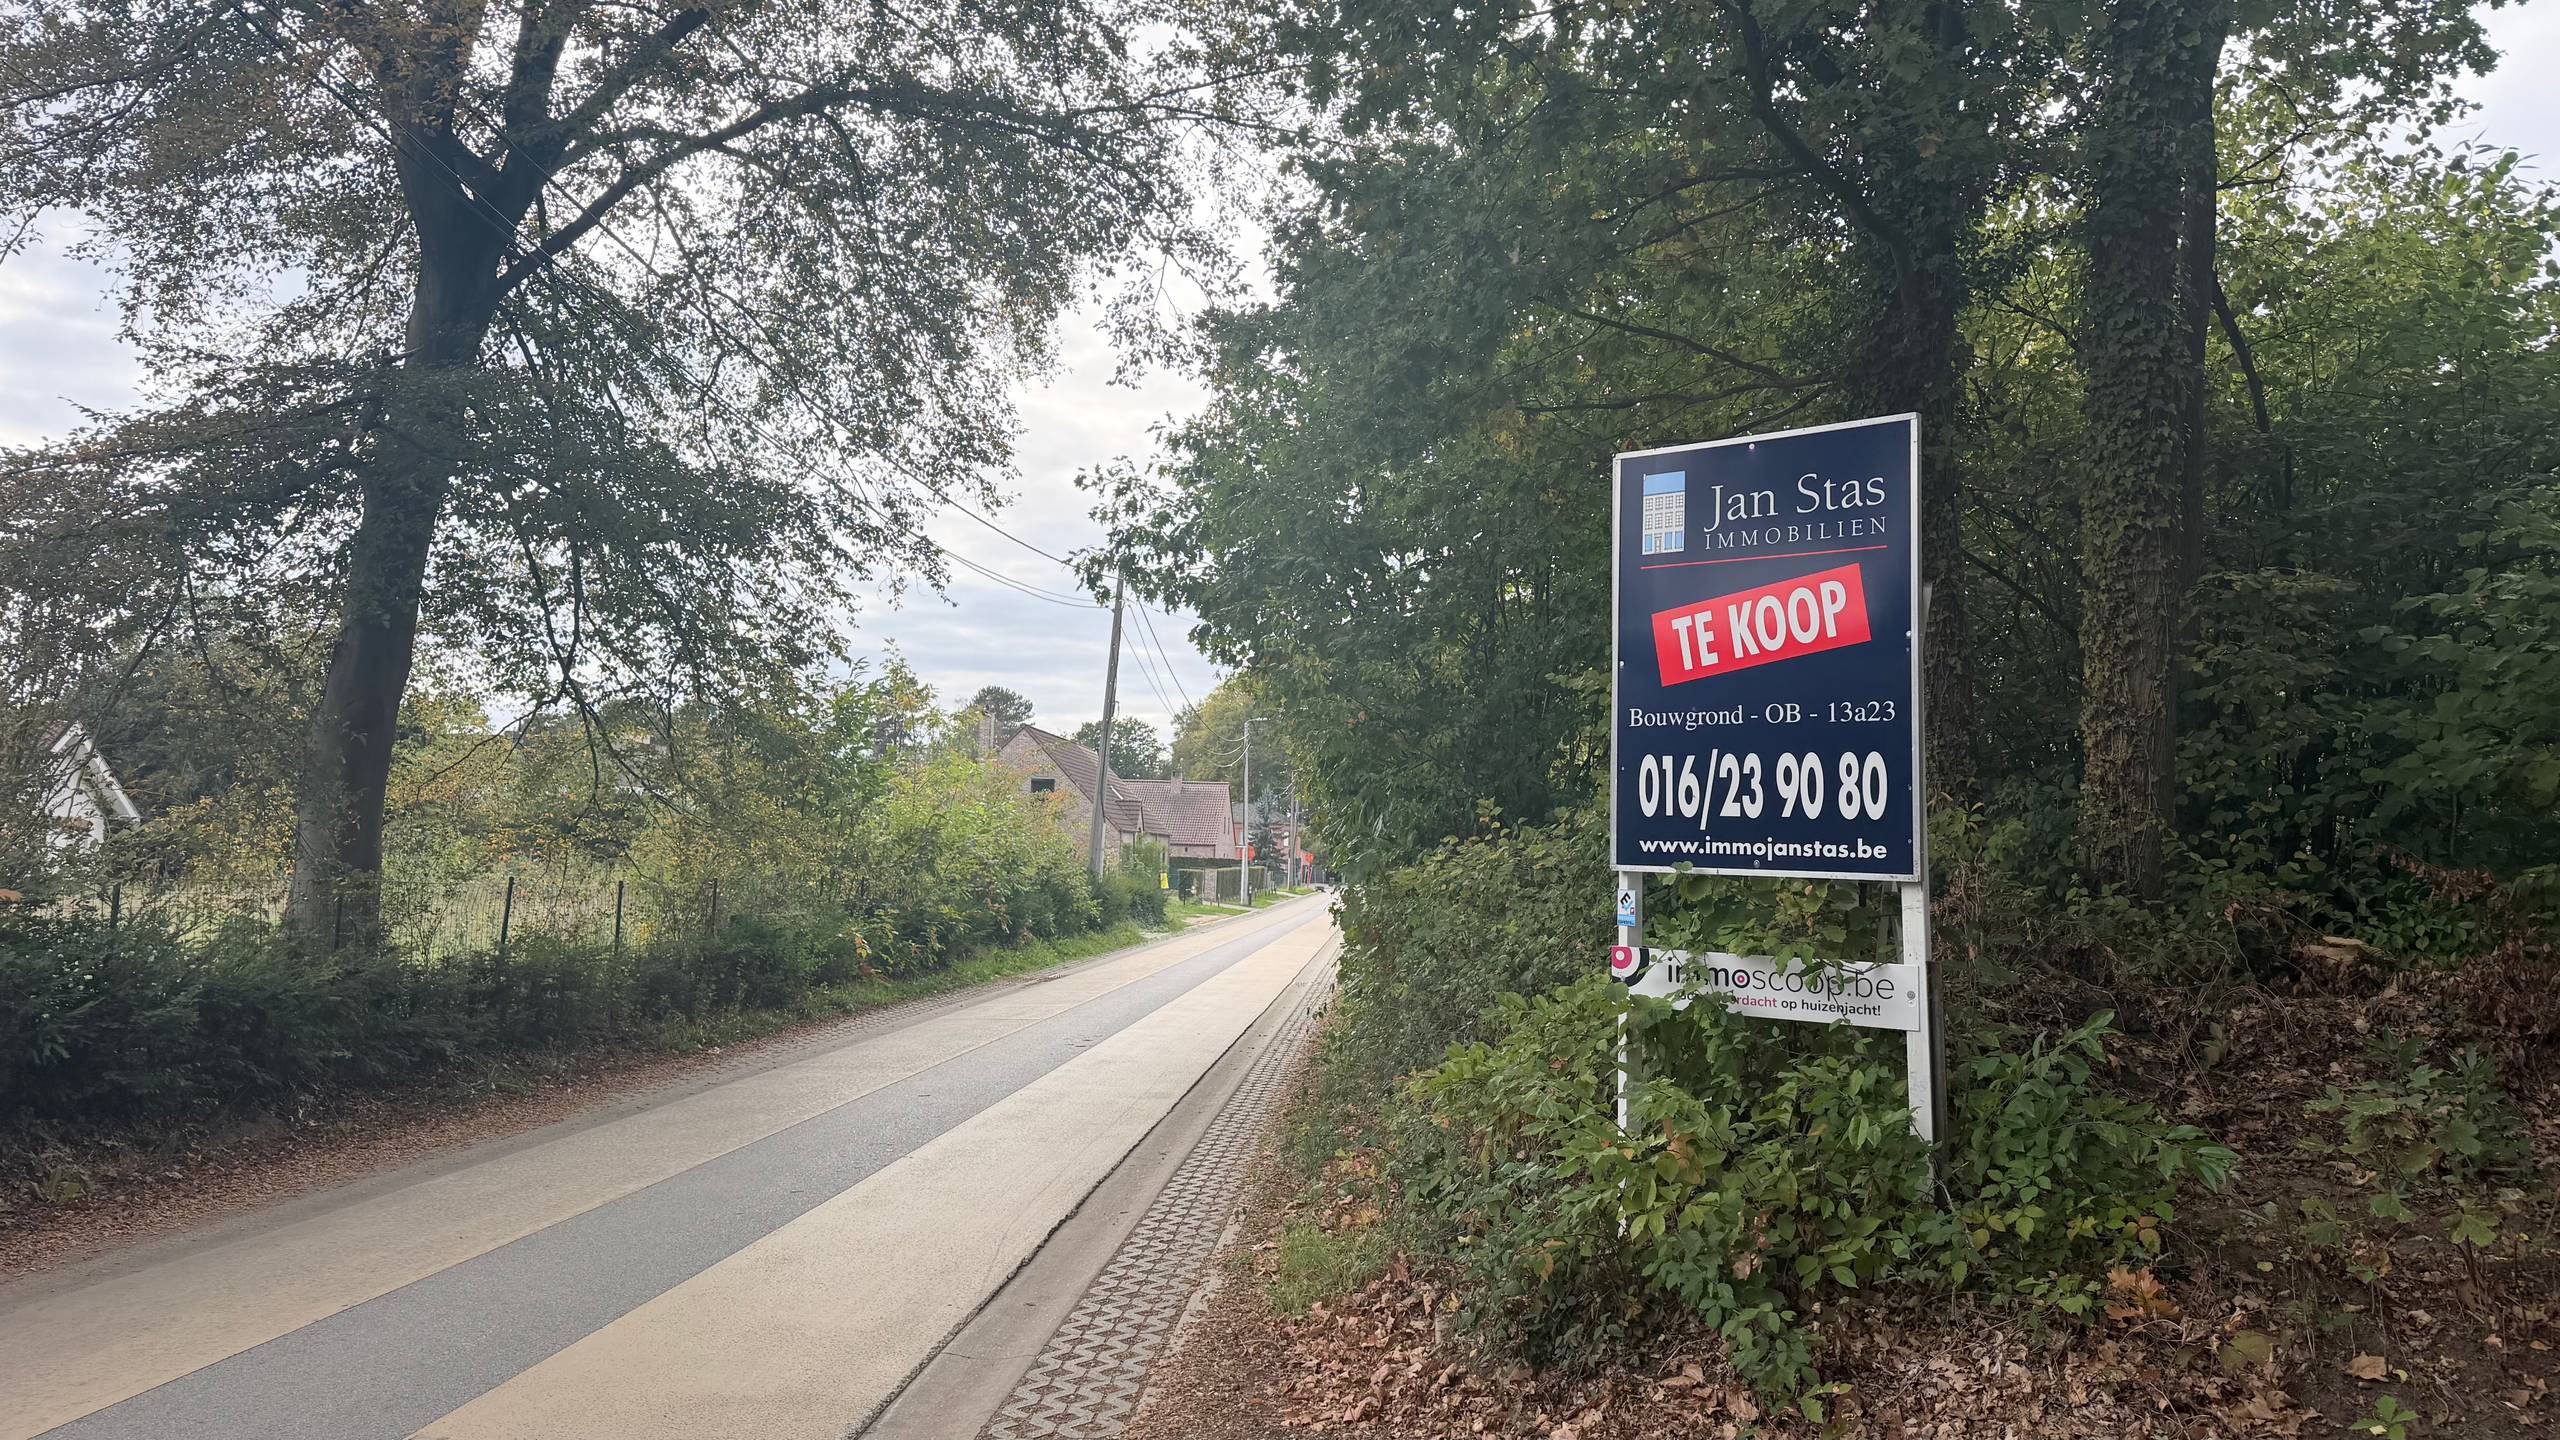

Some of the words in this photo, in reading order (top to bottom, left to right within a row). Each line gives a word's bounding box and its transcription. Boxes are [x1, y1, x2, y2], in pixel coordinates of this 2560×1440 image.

[1704, 484, 1778, 532] Jan
[1797, 473, 1886, 514] Stas
[1705, 516, 1887, 550] IMMOBILIEN
[1671, 610, 1719, 671] TE
[1728, 580, 1847, 659] KOOP
[1628, 705, 1744, 731] Bouwgrond
[1765, 703, 1801, 724] OB
[1827, 700, 1896, 723] 13a23
[1638, 748, 1764, 831] 016/23
[1776, 751, 1825, 820] 90
[1837, 751, 1888, 821] 80
[1639, 836, 1888, 861] www.immojanstas.be
[1781, 1000, 1798, 1011] op
[1801, 999, 1881, 1016] huizenjacht!
